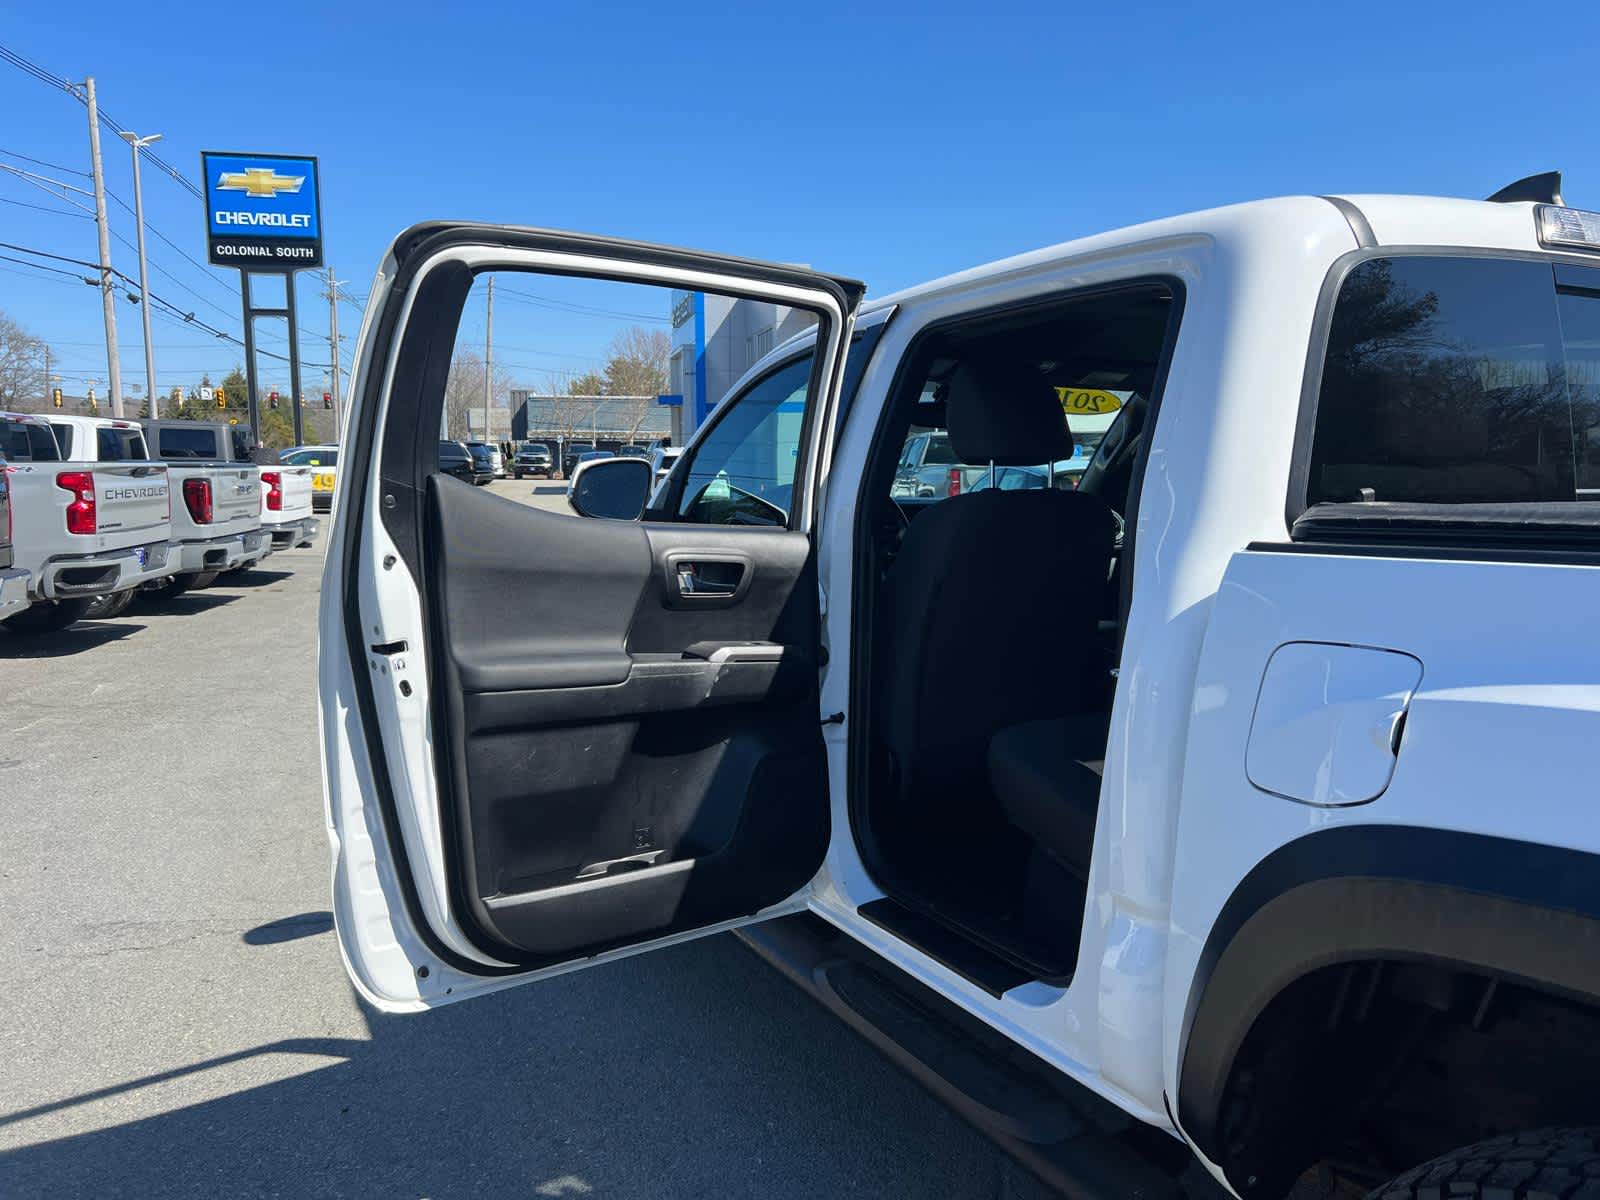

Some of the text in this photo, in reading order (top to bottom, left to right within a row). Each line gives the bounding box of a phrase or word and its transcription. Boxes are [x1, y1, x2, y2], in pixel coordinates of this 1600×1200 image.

[215, 211, 311, 227] CHEVROLET
[216, 245, 314, 257] COLONIAL SOUTH
